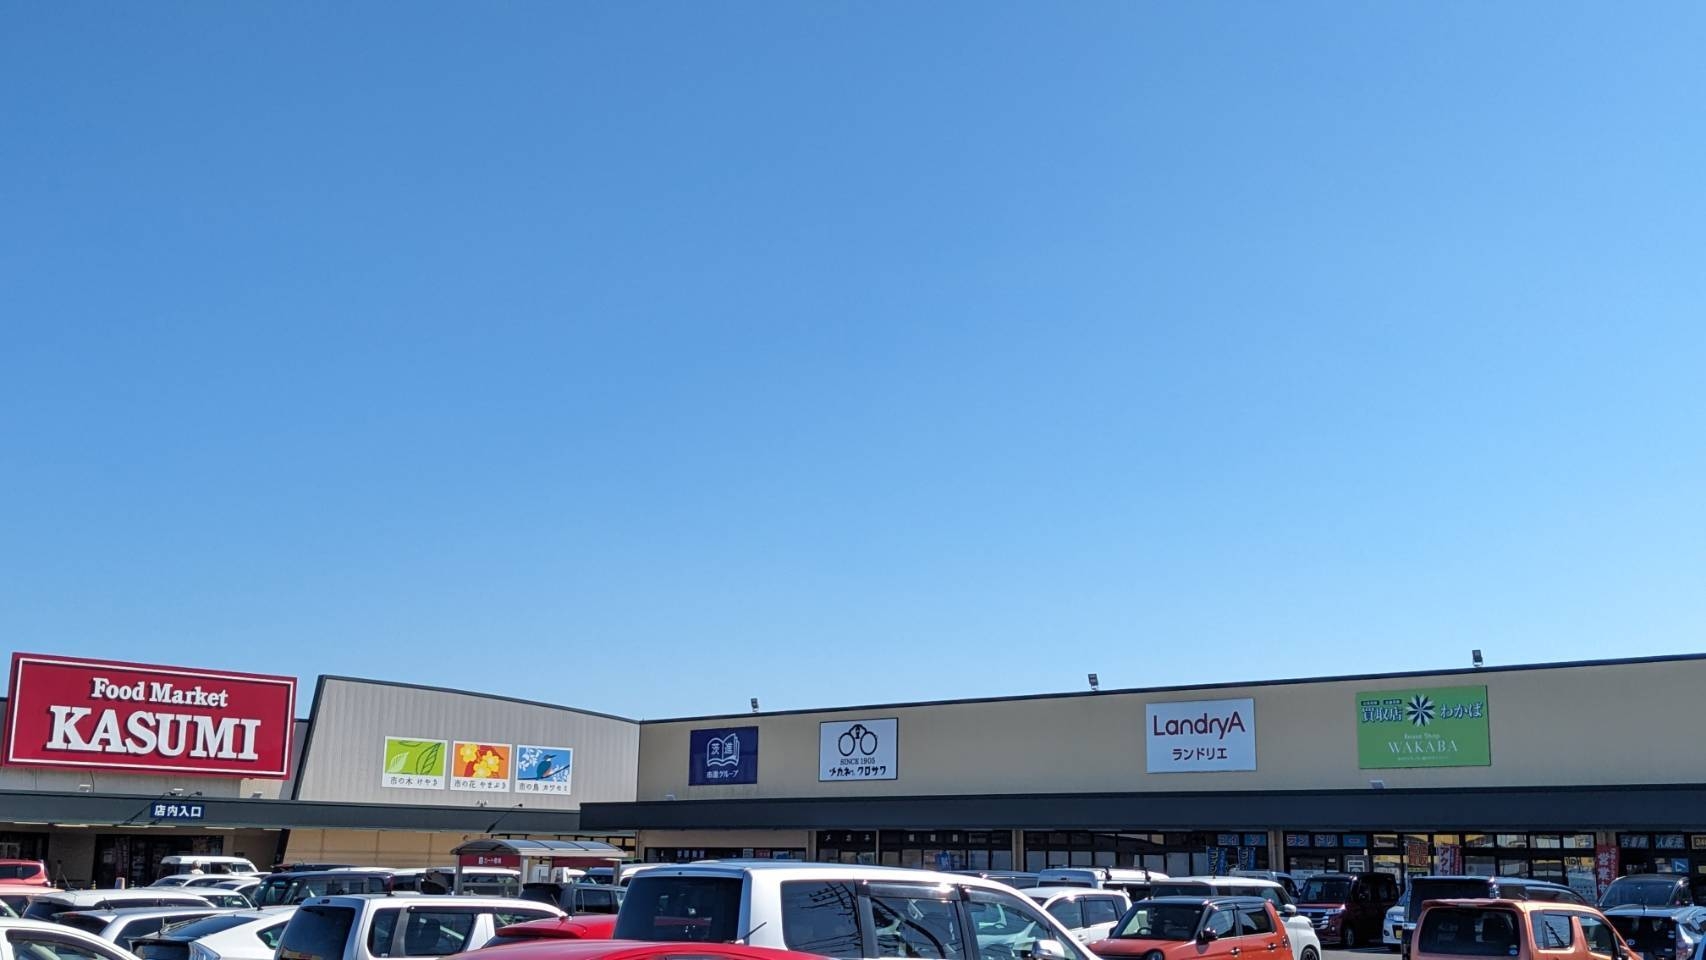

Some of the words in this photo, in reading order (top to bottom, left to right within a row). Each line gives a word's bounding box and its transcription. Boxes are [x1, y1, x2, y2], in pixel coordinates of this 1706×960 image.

[91, 677, 145, 701] Food
[149, 682, 229, 707] Market
[1362, 705, 1403, 723] 買取店
[1440, 702, 1483, 719] わかば
[46, 705, 261, 760] KASUMI
[1153, 711, 1246, 740] LandryA
[1172, 747, 1228, 761] ランドリエ
[1388, 740, 1458, 753] WAKABA
[390, 776, 413, 785] 市の木
[454, 779, 476, 789] 市の花
[154, 804, 202, 818] 店内入口
